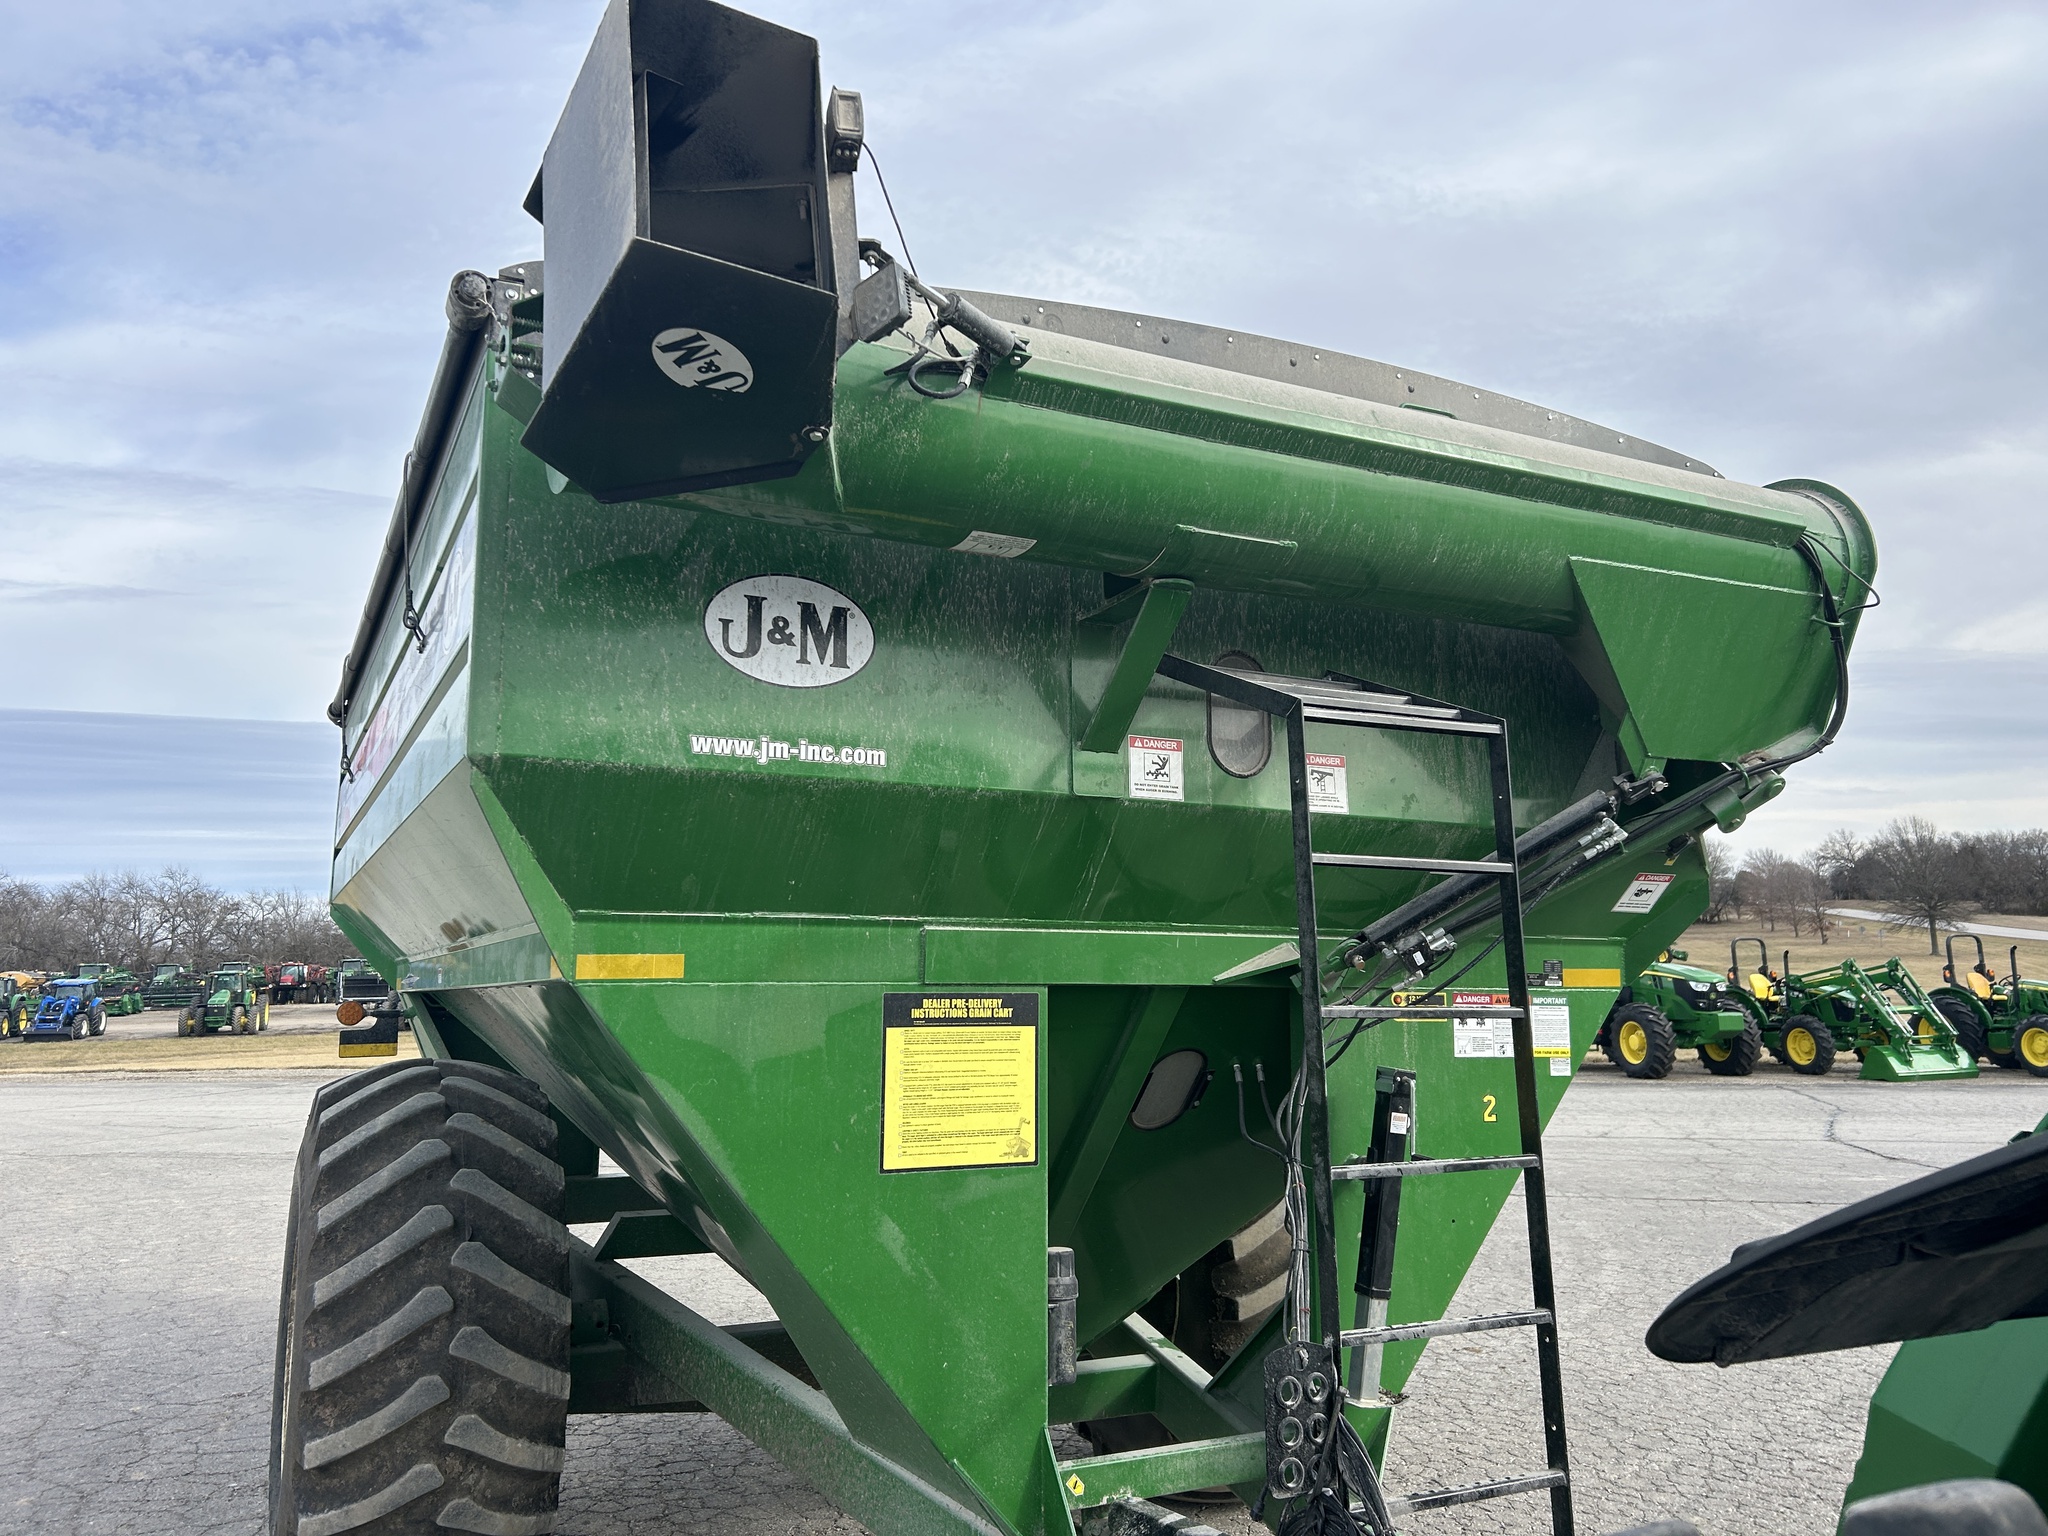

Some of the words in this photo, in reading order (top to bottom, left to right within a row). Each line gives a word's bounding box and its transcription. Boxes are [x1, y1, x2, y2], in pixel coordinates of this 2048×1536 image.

[655, 331, 749, 392] J&M
[718, 594, 851, 669] J&M
[1143, 739, 1178, 750] DANGER
[690, 734, 887, 767] www.jm-inc.com
[1310, 755, 1341, 766] DANGER
[922, 998, 950, 1009] DEALER
[951, 998, 1003, 1009] PRE-DELIVERY
[1462, 995, 1491, 1003] DANGER
[1532, 997, 1567, 1005] IMPORTANT
[911, 1008, 968, 1019] INSTRUCTIONS
[968, 1008, 993, 1018] GRAIN
[993, 1007, 1014, 1018] CART
[1483, 1094, 1498, 1122] 2
